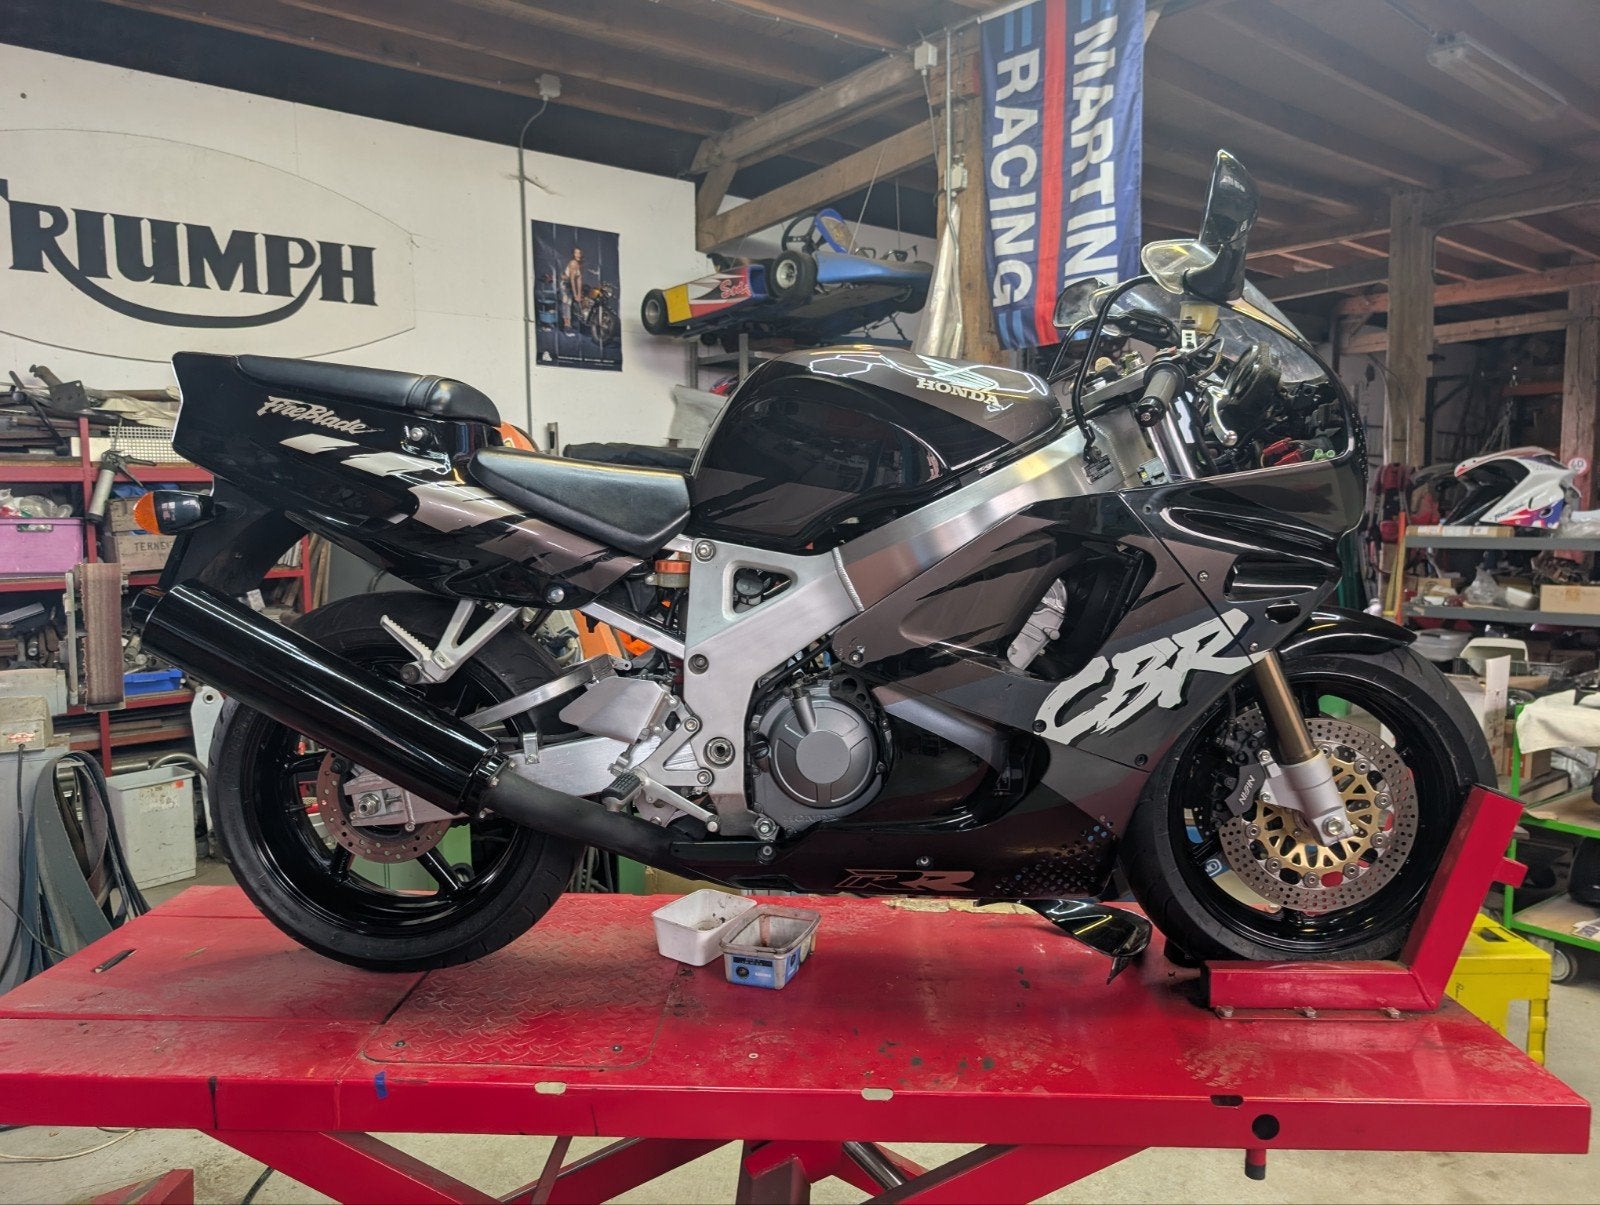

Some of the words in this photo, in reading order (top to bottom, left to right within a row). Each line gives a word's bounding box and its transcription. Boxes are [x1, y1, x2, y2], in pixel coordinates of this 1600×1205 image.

[989, 48, 1041, 308] RACING
[0, 178, 378, 328] RIUMPH
[256, 395, 384, 434] FireBlade
[916, 377, 1001, 406] HONDA
[1034, 608, 1271, 745] CBR
[834, 869, 976, 892] RR
